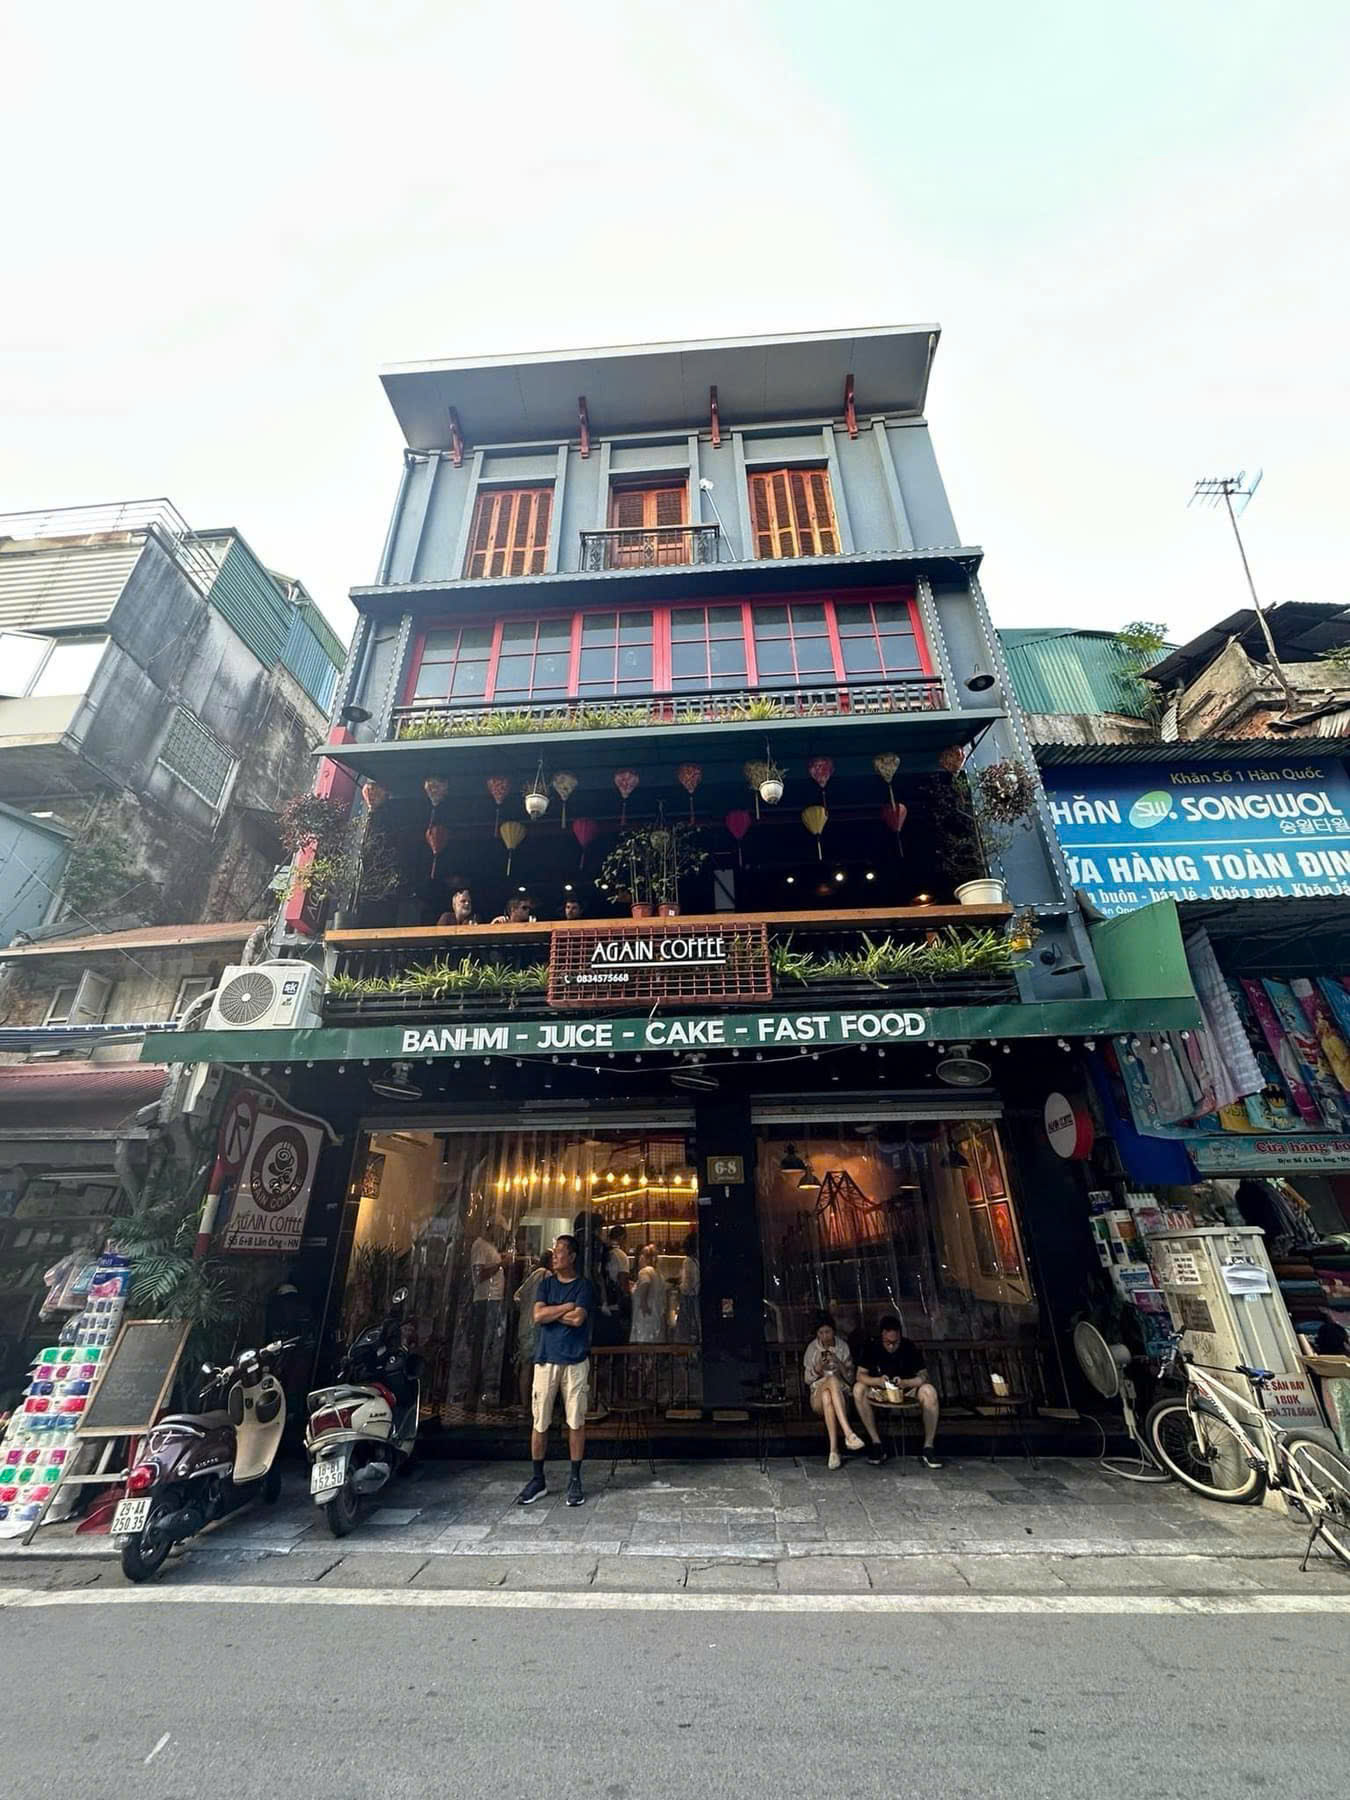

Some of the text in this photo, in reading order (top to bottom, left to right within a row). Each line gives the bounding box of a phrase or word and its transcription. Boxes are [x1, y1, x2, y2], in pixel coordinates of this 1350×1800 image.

[1236, 770, 1244, 782] 1
[1181, 791, 1343, 821] SONGWOL
[1107, 851, 1200, 883] HÀNG
[1202, 848, 1294, 880] TOÀN
[591, 937, 726, 962] AGAIN COFFEE
[402, 1027, 509, 1052] BANHMI
[537, 1024, 612, 1048] JUICE
[645, 1020, 725, 1045] CAKE
[758, 1016, 830, 1041] FAST
[840, 1013, 926, 1038] FOOD
